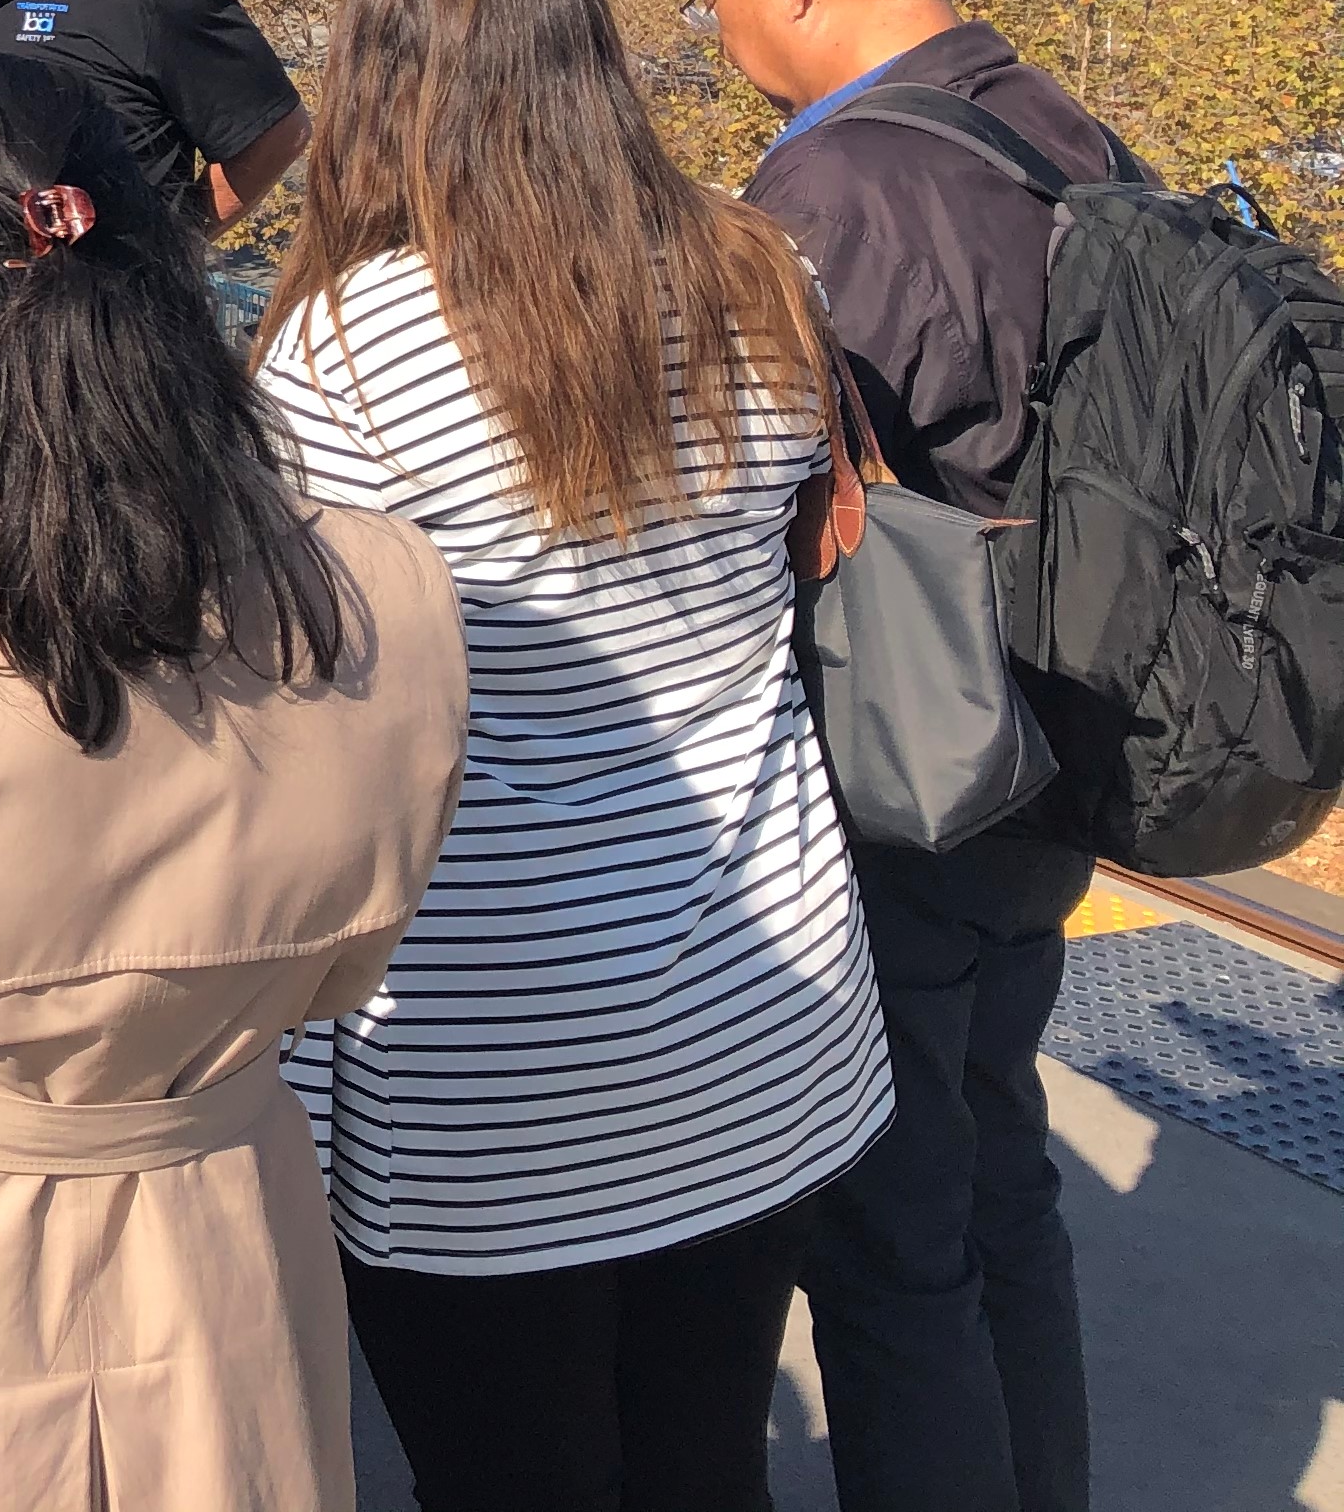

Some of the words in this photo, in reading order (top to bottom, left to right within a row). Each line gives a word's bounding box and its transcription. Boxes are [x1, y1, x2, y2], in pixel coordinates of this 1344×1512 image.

[15, 33, 42, 43] SAFETY
[1247, 570, 1267, 622] EQUENT
[1242, 623, 1254, 654] LYER
[1241, 654, 1256, 670] 30
